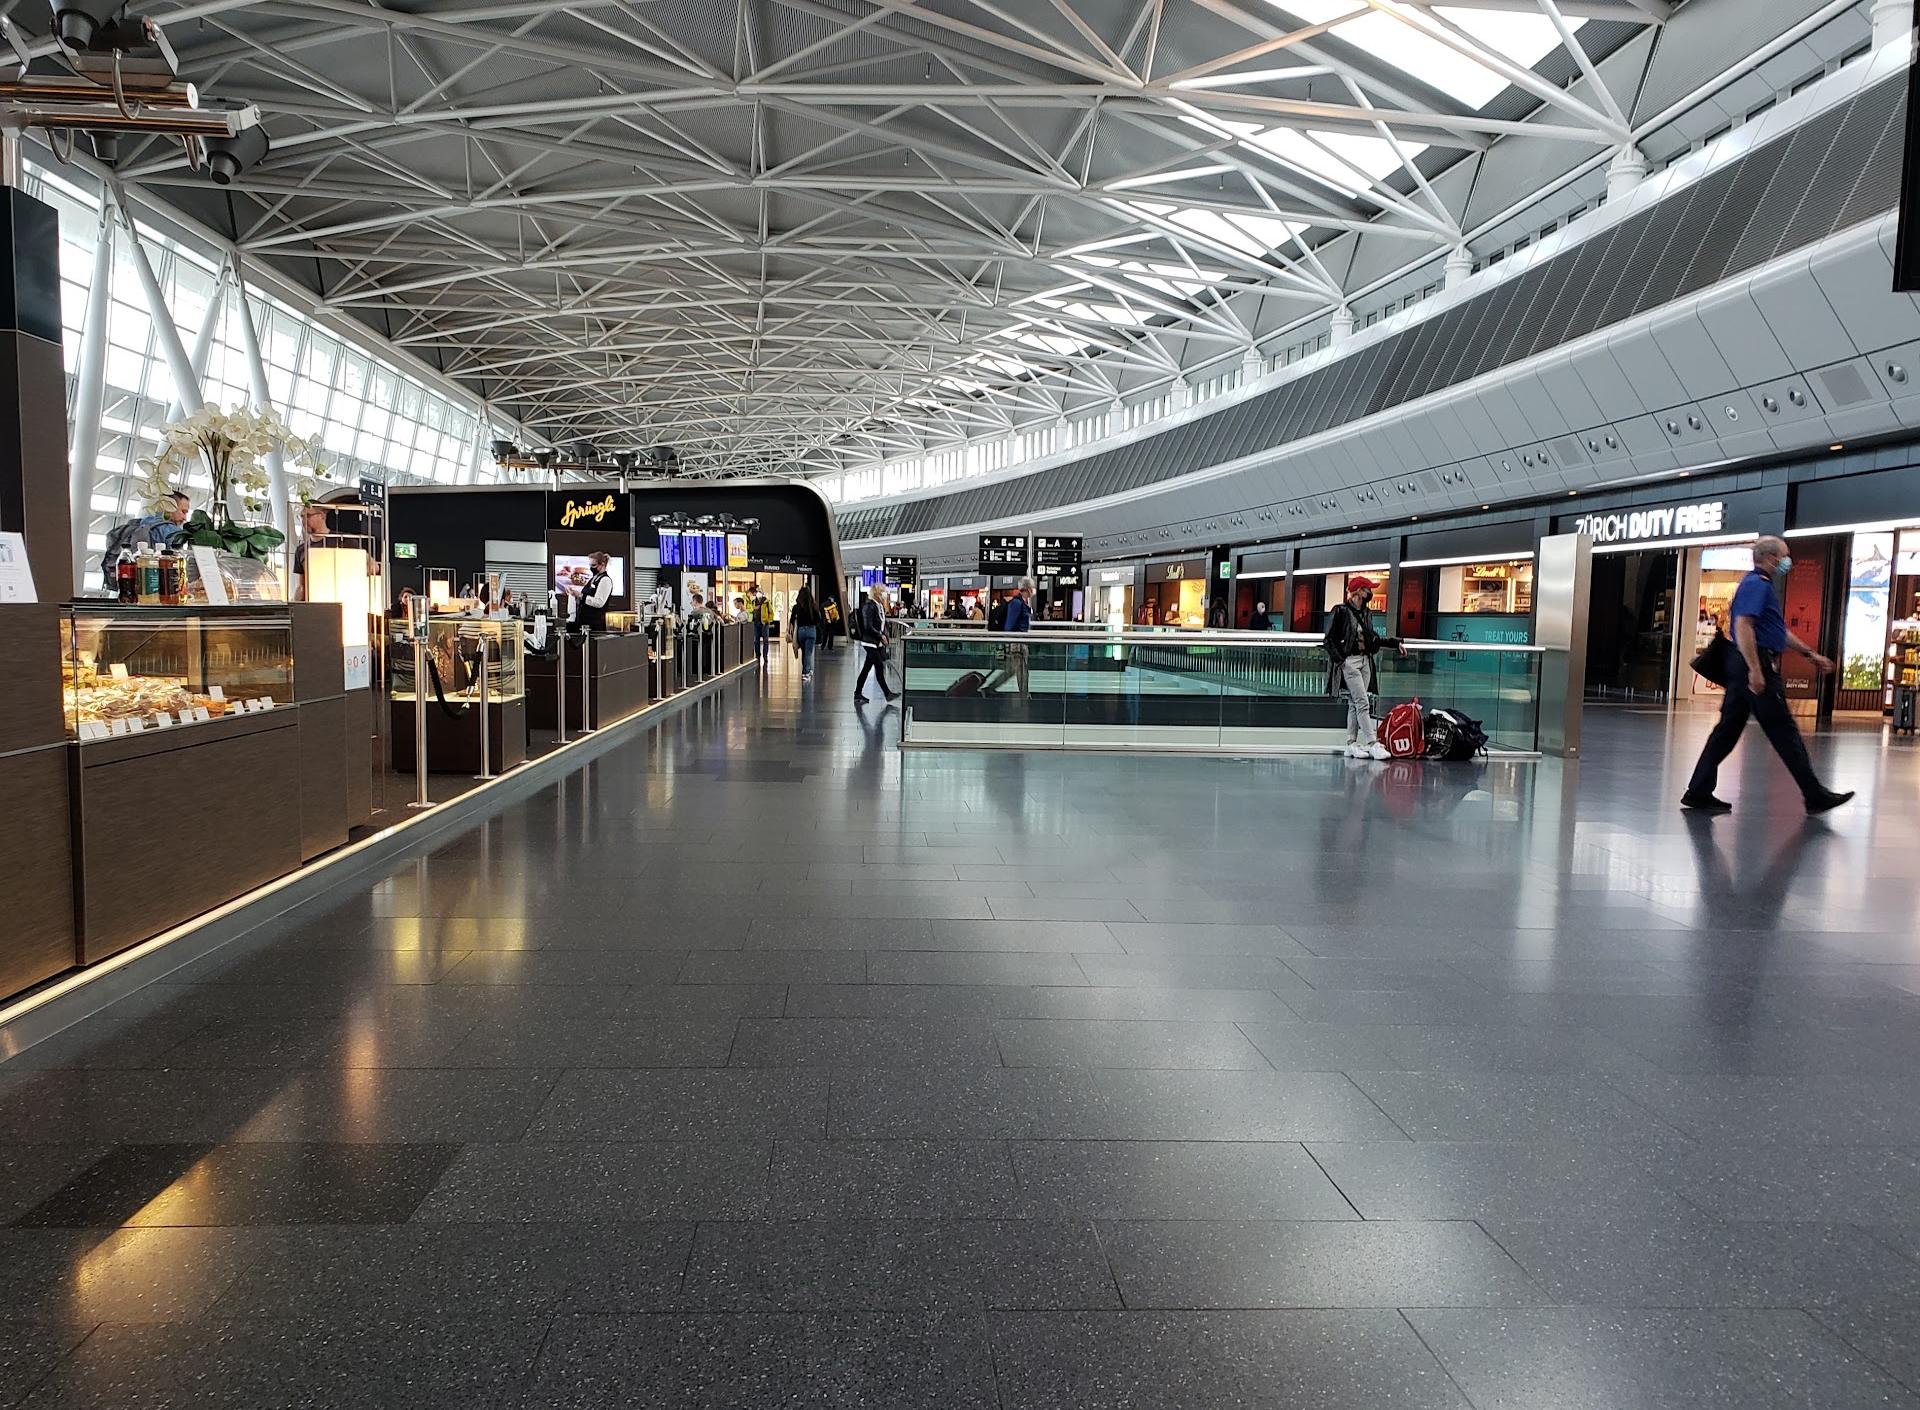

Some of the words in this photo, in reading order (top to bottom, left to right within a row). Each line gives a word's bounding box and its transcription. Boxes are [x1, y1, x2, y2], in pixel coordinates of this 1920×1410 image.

[561, 495, 616, 527] Sprüngli
[1575, 514, 1627, 542] ZÜRICH
[1629, 508, 1674, 539] DUTY
[1675, 502, 1723, 534] FREE
[1054, 539, 1060, 547] A
[1473, 566, 1499, 577] Lindt
[1485, 631, 1504, 641] TREAT
